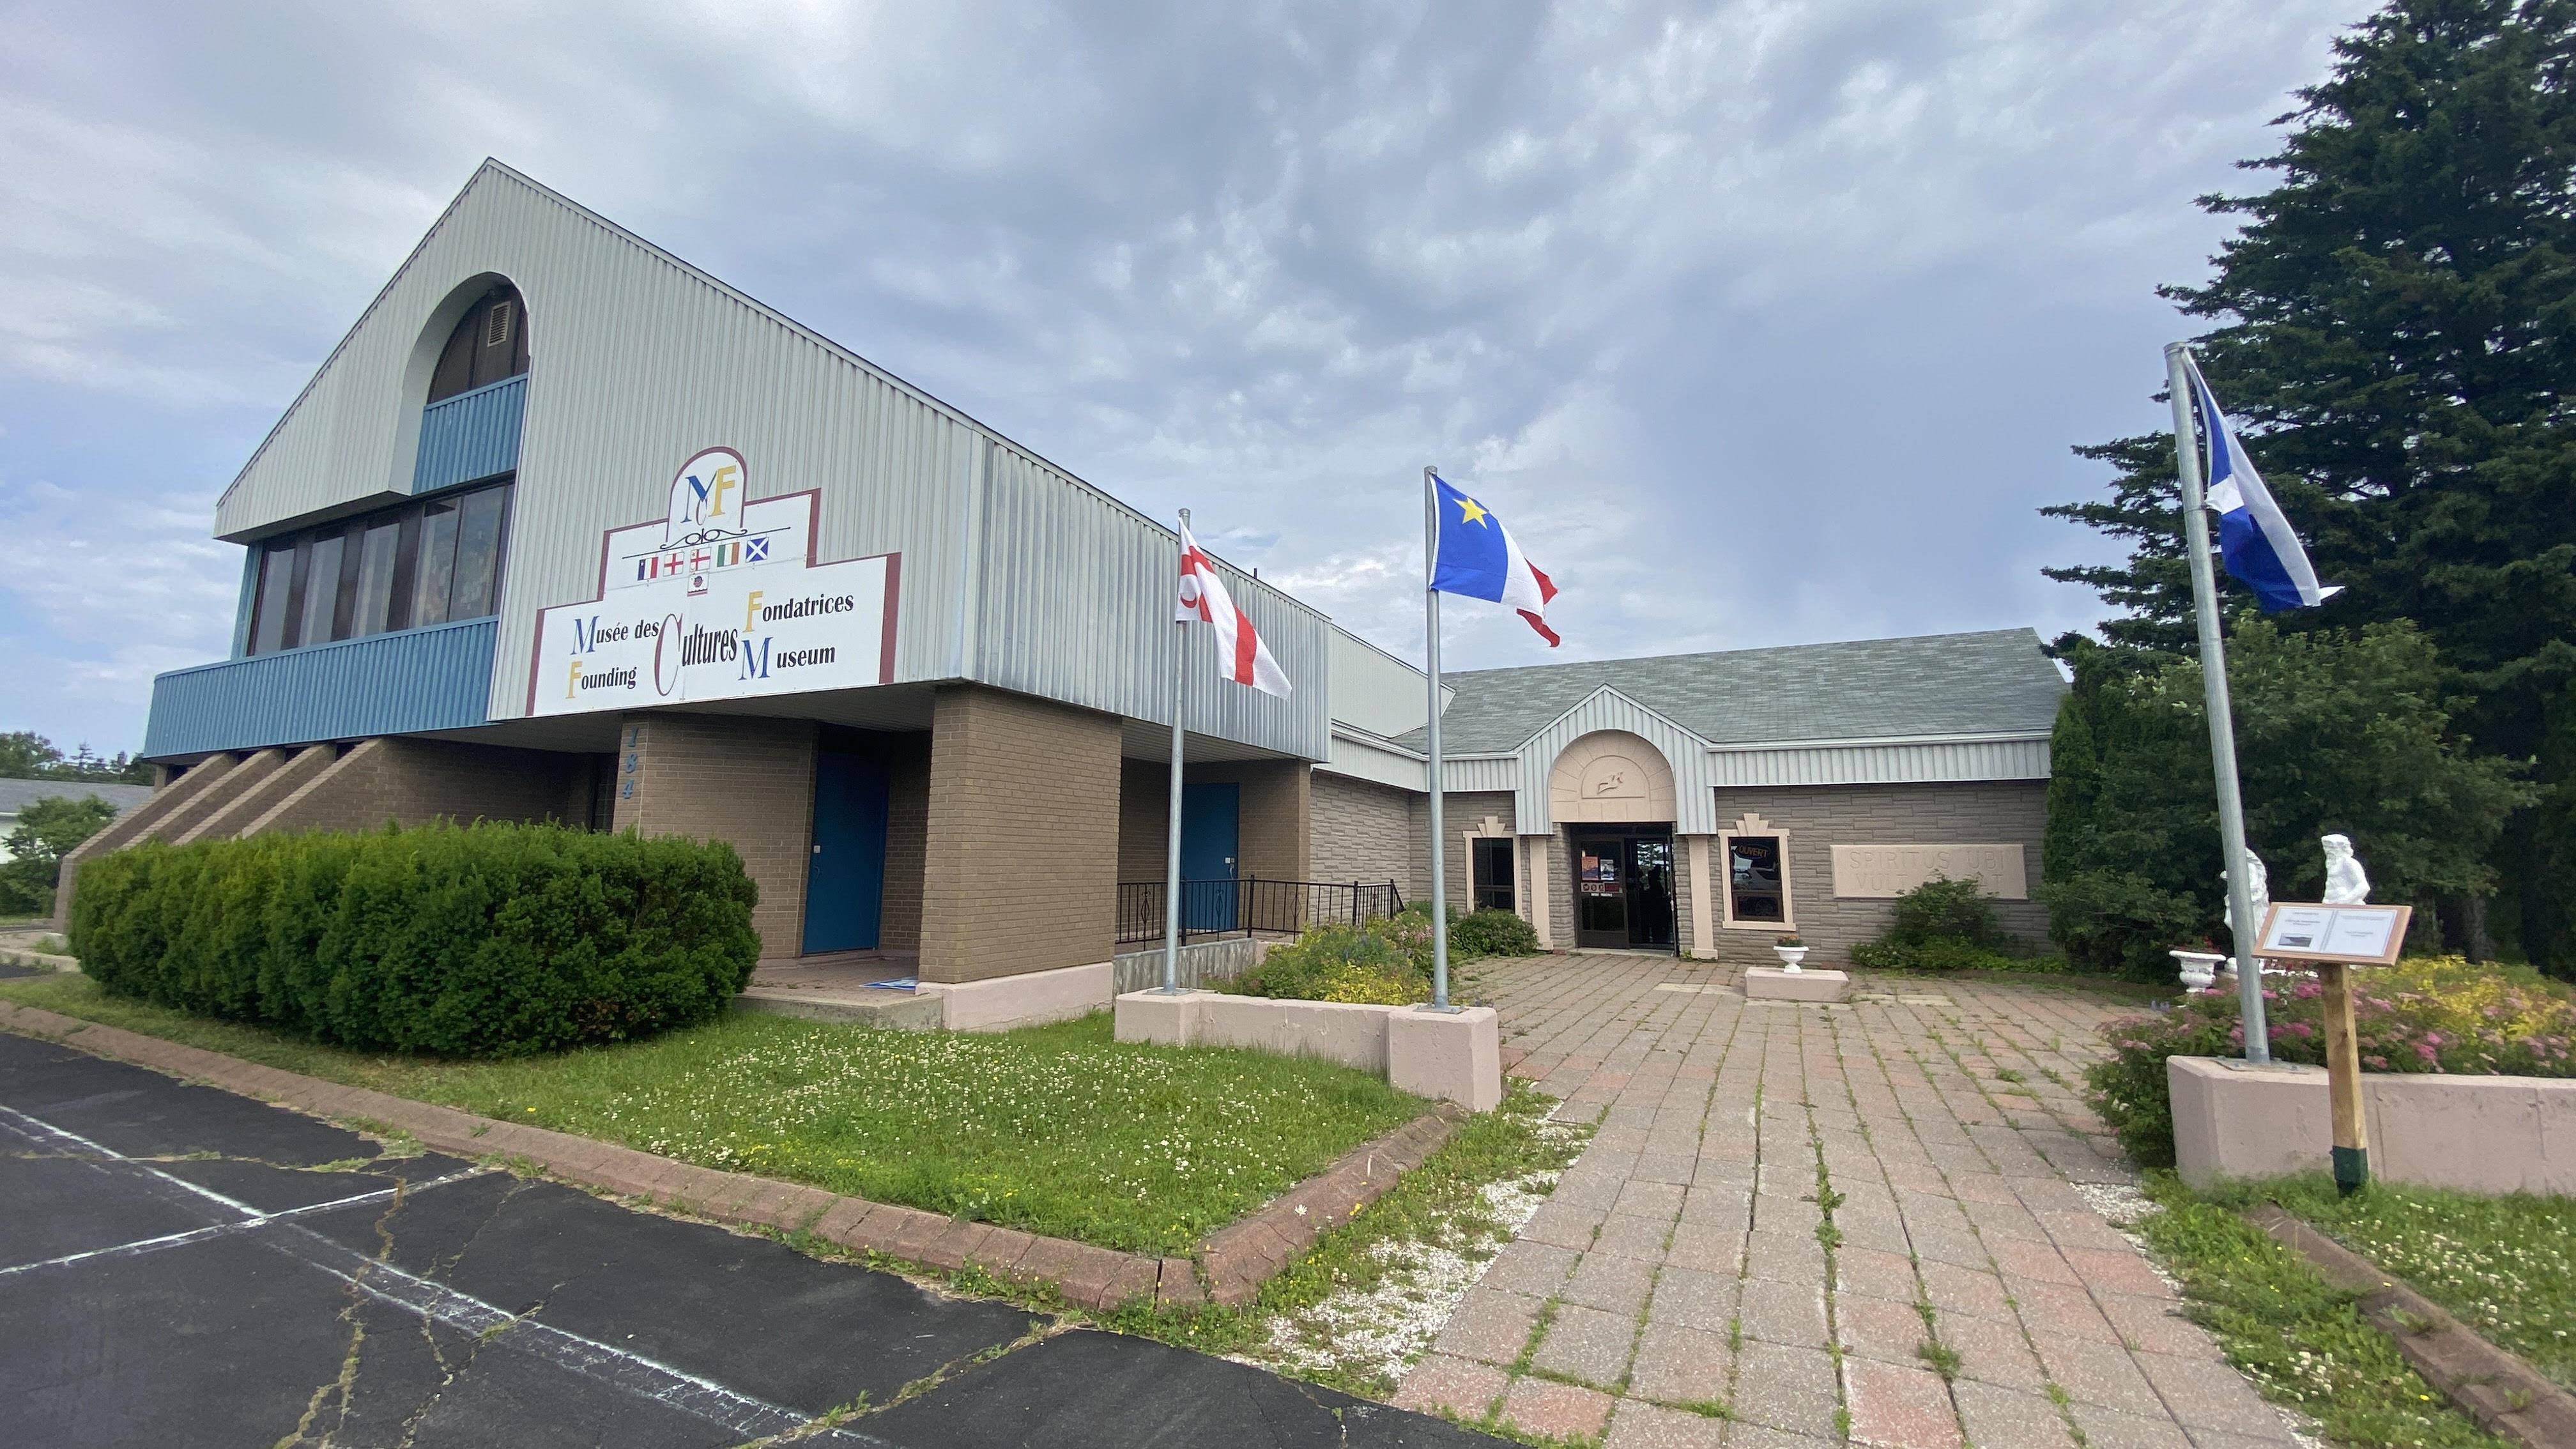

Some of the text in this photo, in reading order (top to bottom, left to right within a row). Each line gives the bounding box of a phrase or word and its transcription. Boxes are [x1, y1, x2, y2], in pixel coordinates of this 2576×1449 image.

[570, 591, 854, 696] Musée des Cultures Fondatrices
[565, 637, 836, 699] Founding Museum
[622, 726, 638, 799] 184
[1739, 845, 1767, 857] OUVERT
[1850, 851, 2004, 870] SPIRITUS UBI
[1855, 873, 1908, 891] VULT
